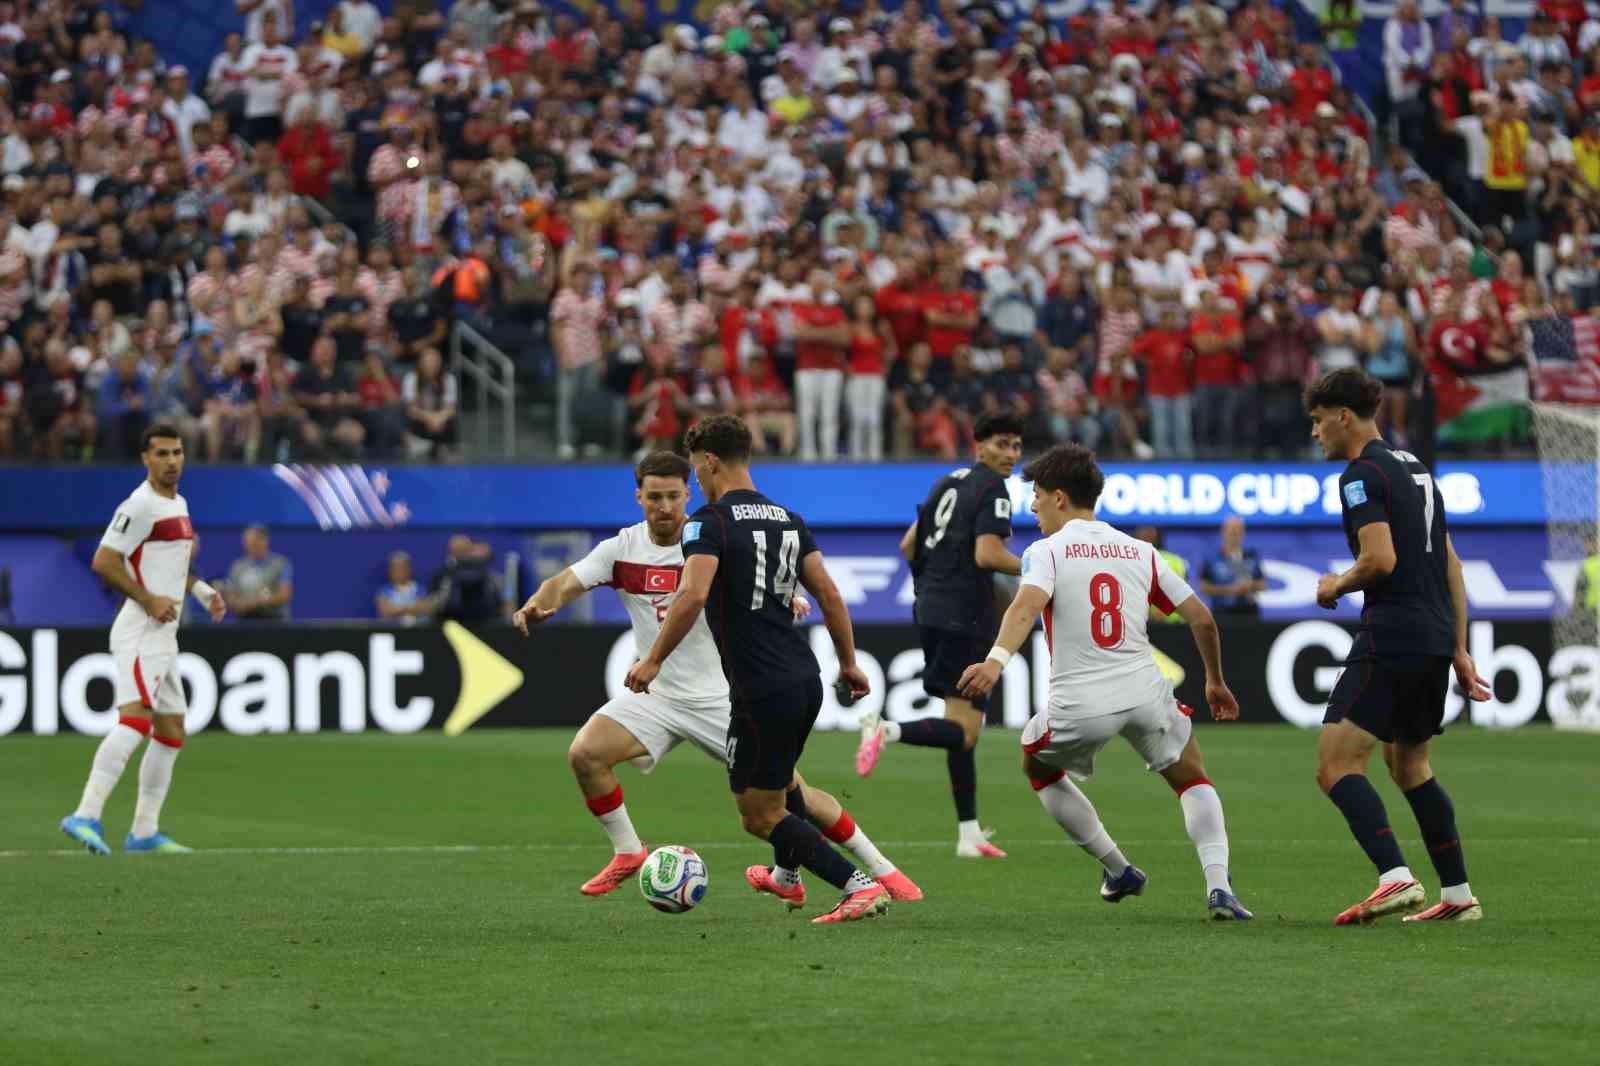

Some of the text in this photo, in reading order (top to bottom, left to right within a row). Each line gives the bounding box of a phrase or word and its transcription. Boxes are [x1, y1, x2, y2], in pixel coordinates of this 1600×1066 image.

[925, 488, 957, 549] 9
[1094, 473, 1225, 515] ORLD
[1227, 473, 1320, 515] CUP
[1411, 473, 1434, 553] 7
[751, 530, 800, 610] 14
[1065, 543, 1098, 559] ARDA
[1089, 572, 1125, 651] 8
